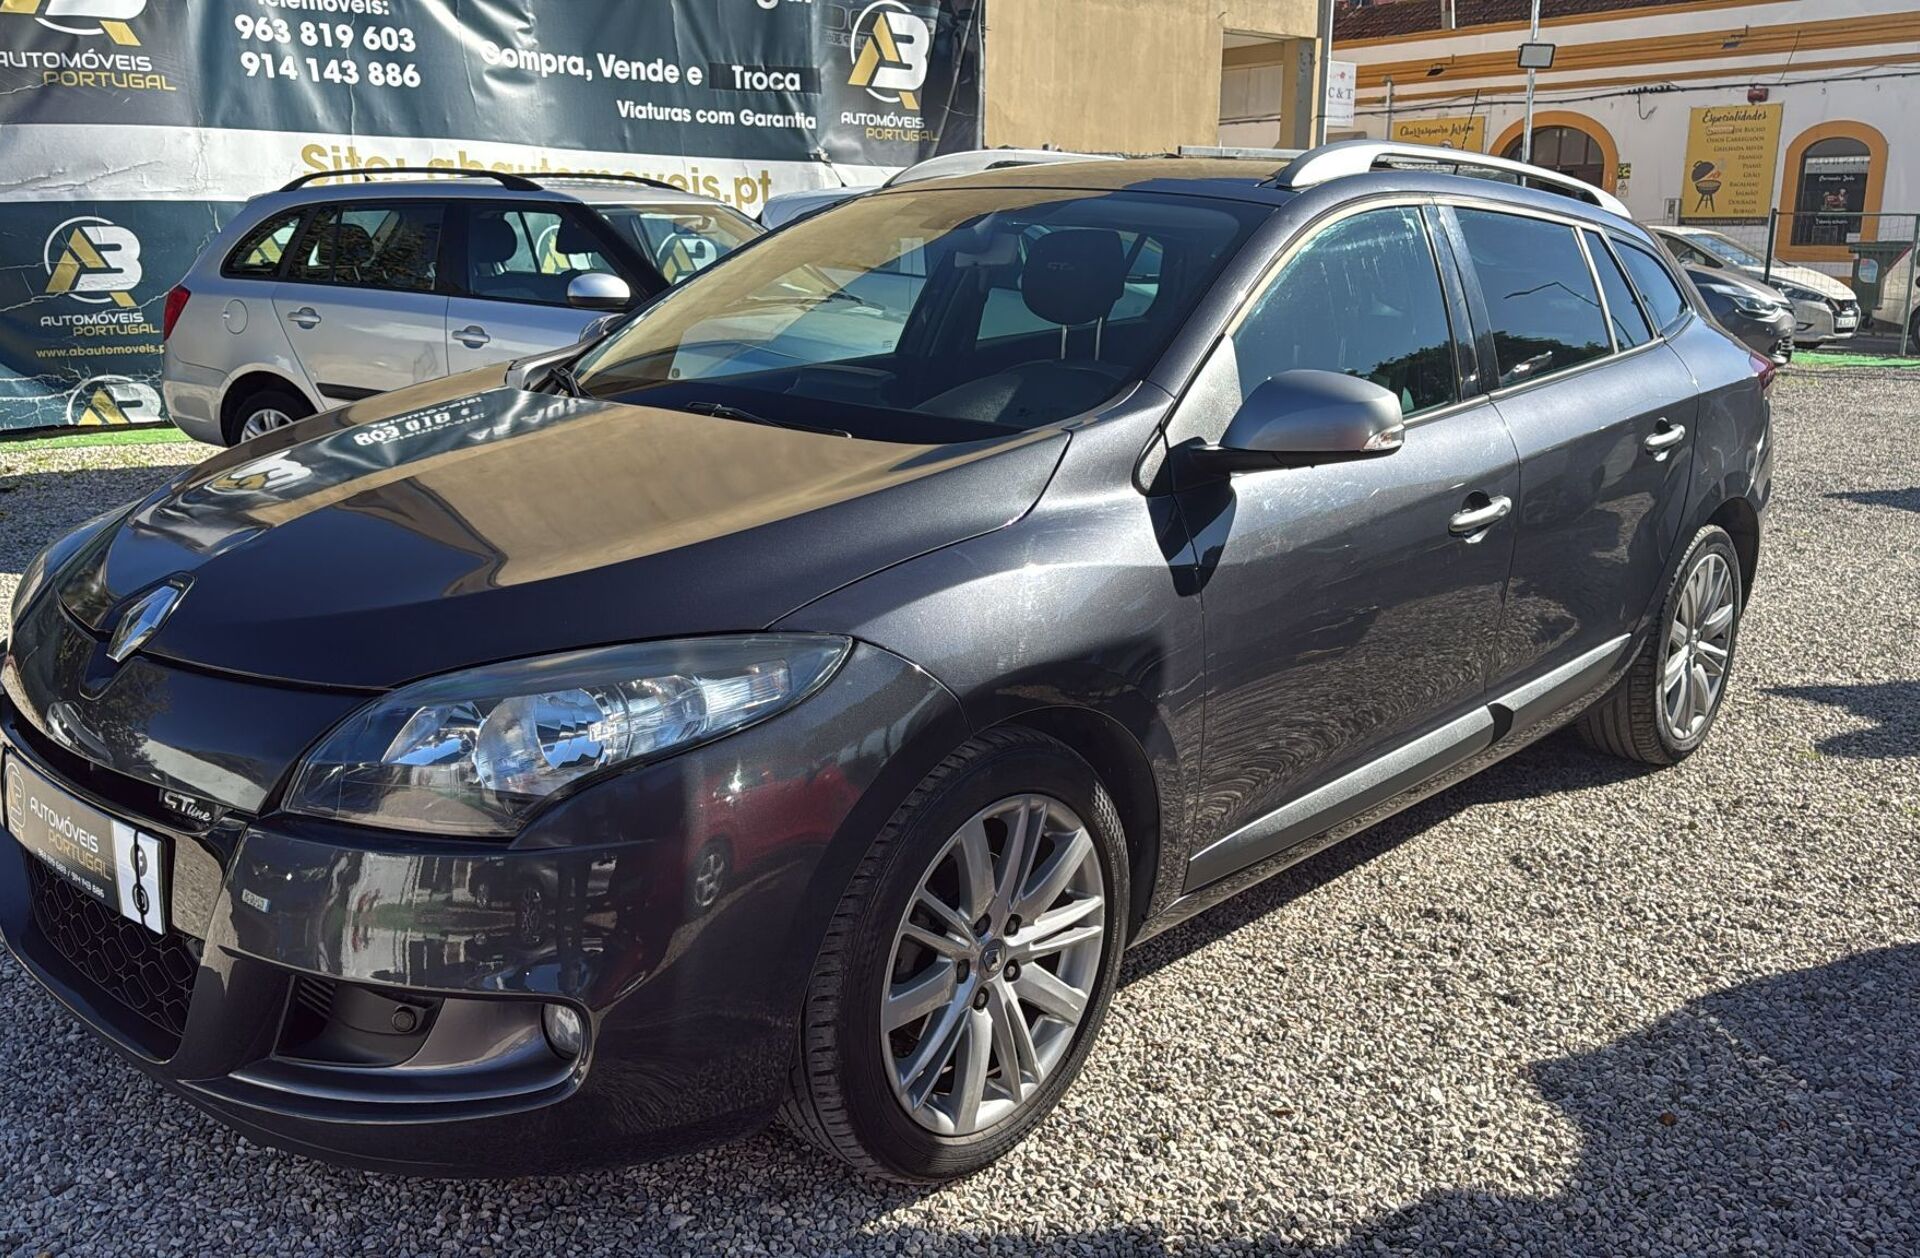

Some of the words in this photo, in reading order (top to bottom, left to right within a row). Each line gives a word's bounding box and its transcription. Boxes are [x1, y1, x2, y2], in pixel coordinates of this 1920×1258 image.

[257, 0, 390, 15] emveis:
[234, 14, 291, 44] 963
[300, 21, 354, 49] 819
[363, 26, 417, 52] 603
[240, 51, 298, 81] 914
[305, 57, 360, 85] 143
[368, 61, 421, 88] 886
[481, 41, 593, 82] Compra,
[597, 53, 680, 84] Vende
[686, 65, 703, 86] e
[732, 65, 801, 92] Troca
[43, 71, 177, 91] PORTUGAL
[617, 99, 691, 123] Viaturas
[696, 107, 735, 126] com
[739, 109, 817, 130] Garantia
[840, 111, 925, 129] AUTOMÓVEIS
[1702, 108, 1767, 125] Especialidades
[865, 128, 940, 142] PORTUGAL
[40, 311, 145, 327] AUTOMÓVEIS
[73, 323, 161, 337] PORTUGAL
[35, 343, 165, 358] www.abautomoveis.p
[30, 796, 100, 854] AUTOMÓVEIS
[46, 829, 113, 881] PORTUGAL
